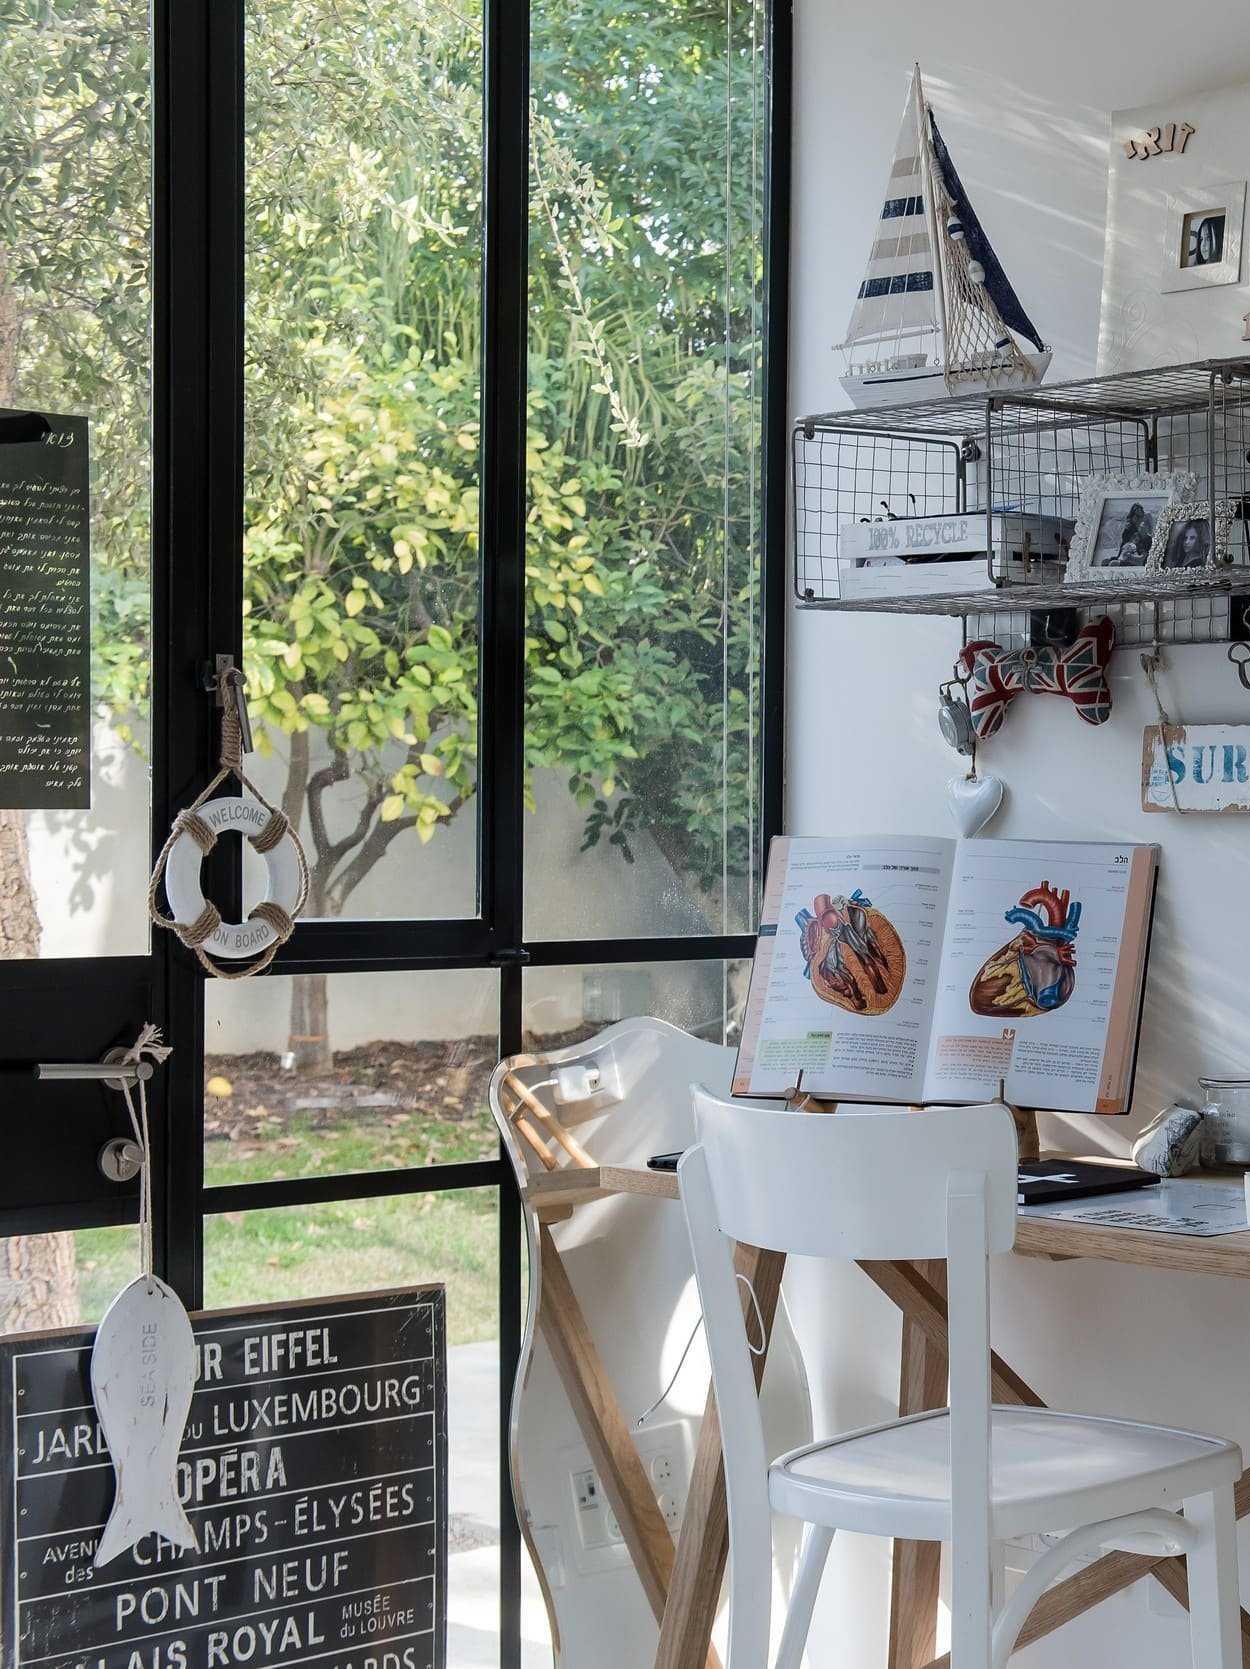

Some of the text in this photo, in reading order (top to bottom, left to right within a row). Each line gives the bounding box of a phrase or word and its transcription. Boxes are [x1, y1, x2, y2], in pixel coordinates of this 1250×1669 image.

[868, 520, 968, 551] 100% RECYCLE
[209, 805, 265, 827] WELCOME
[213, 925, 269, 948] ON BOARD
[244, 1327, 338, 1376] EIFFEL
[213, 1375, 420, 1436] LUXEMBOURG
[176, 1446, 287, 1505] OPÉRA
[65, 1565, 94, 1584] des
[116, 1551, 349, 1632] PONT NEUF
[342, 1594, 391, 1620] MUSÉE
[208, 1612, 325, 1668] ROYAL
[340, 1609, 415, 1640] du LOUVRE
